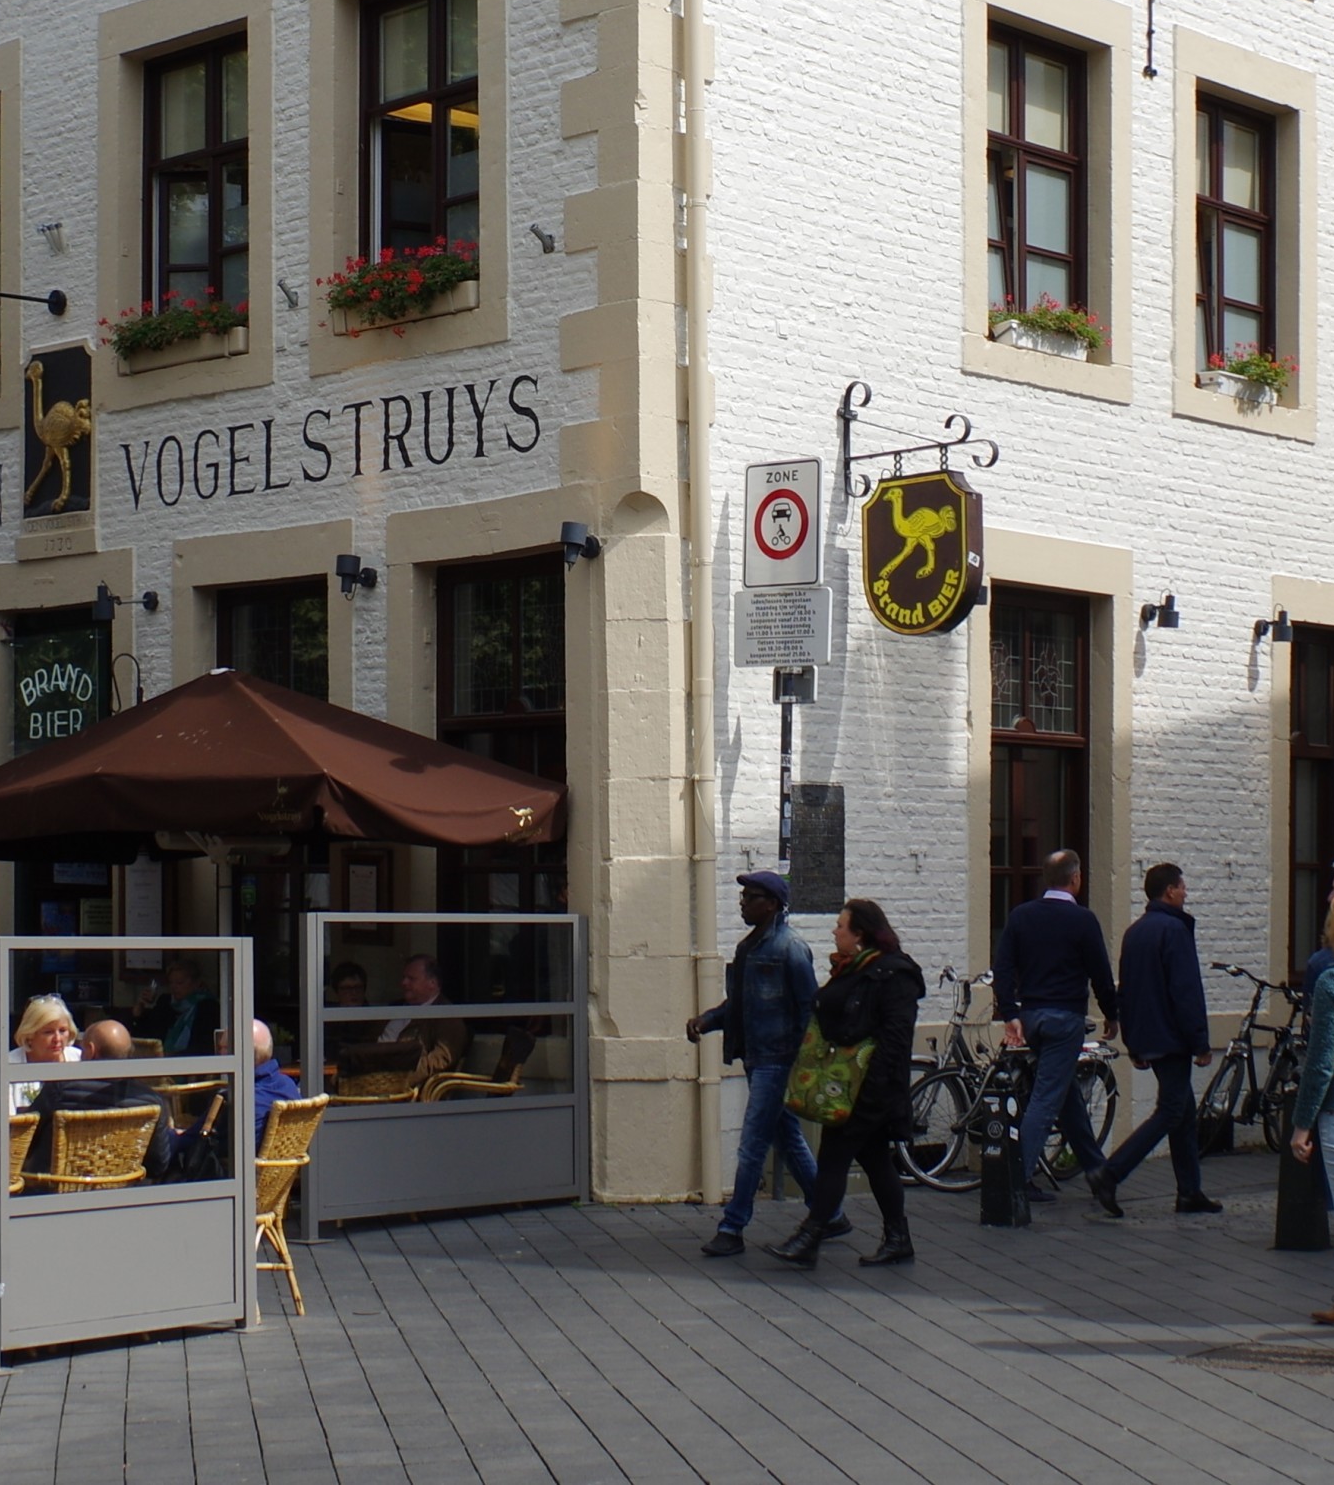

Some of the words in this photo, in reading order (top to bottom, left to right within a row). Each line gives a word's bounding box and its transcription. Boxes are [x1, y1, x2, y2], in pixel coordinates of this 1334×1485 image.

[118, 374, 541, 512] VOGELSTRUYS
[766, 469, 799, 483] ZONE
[873, 579, 925, 625] Brand
[928, 569, 960, 618] BIER
[20, 663, 93, 707] BRAND
[29, 709, 83, 739] BIER
